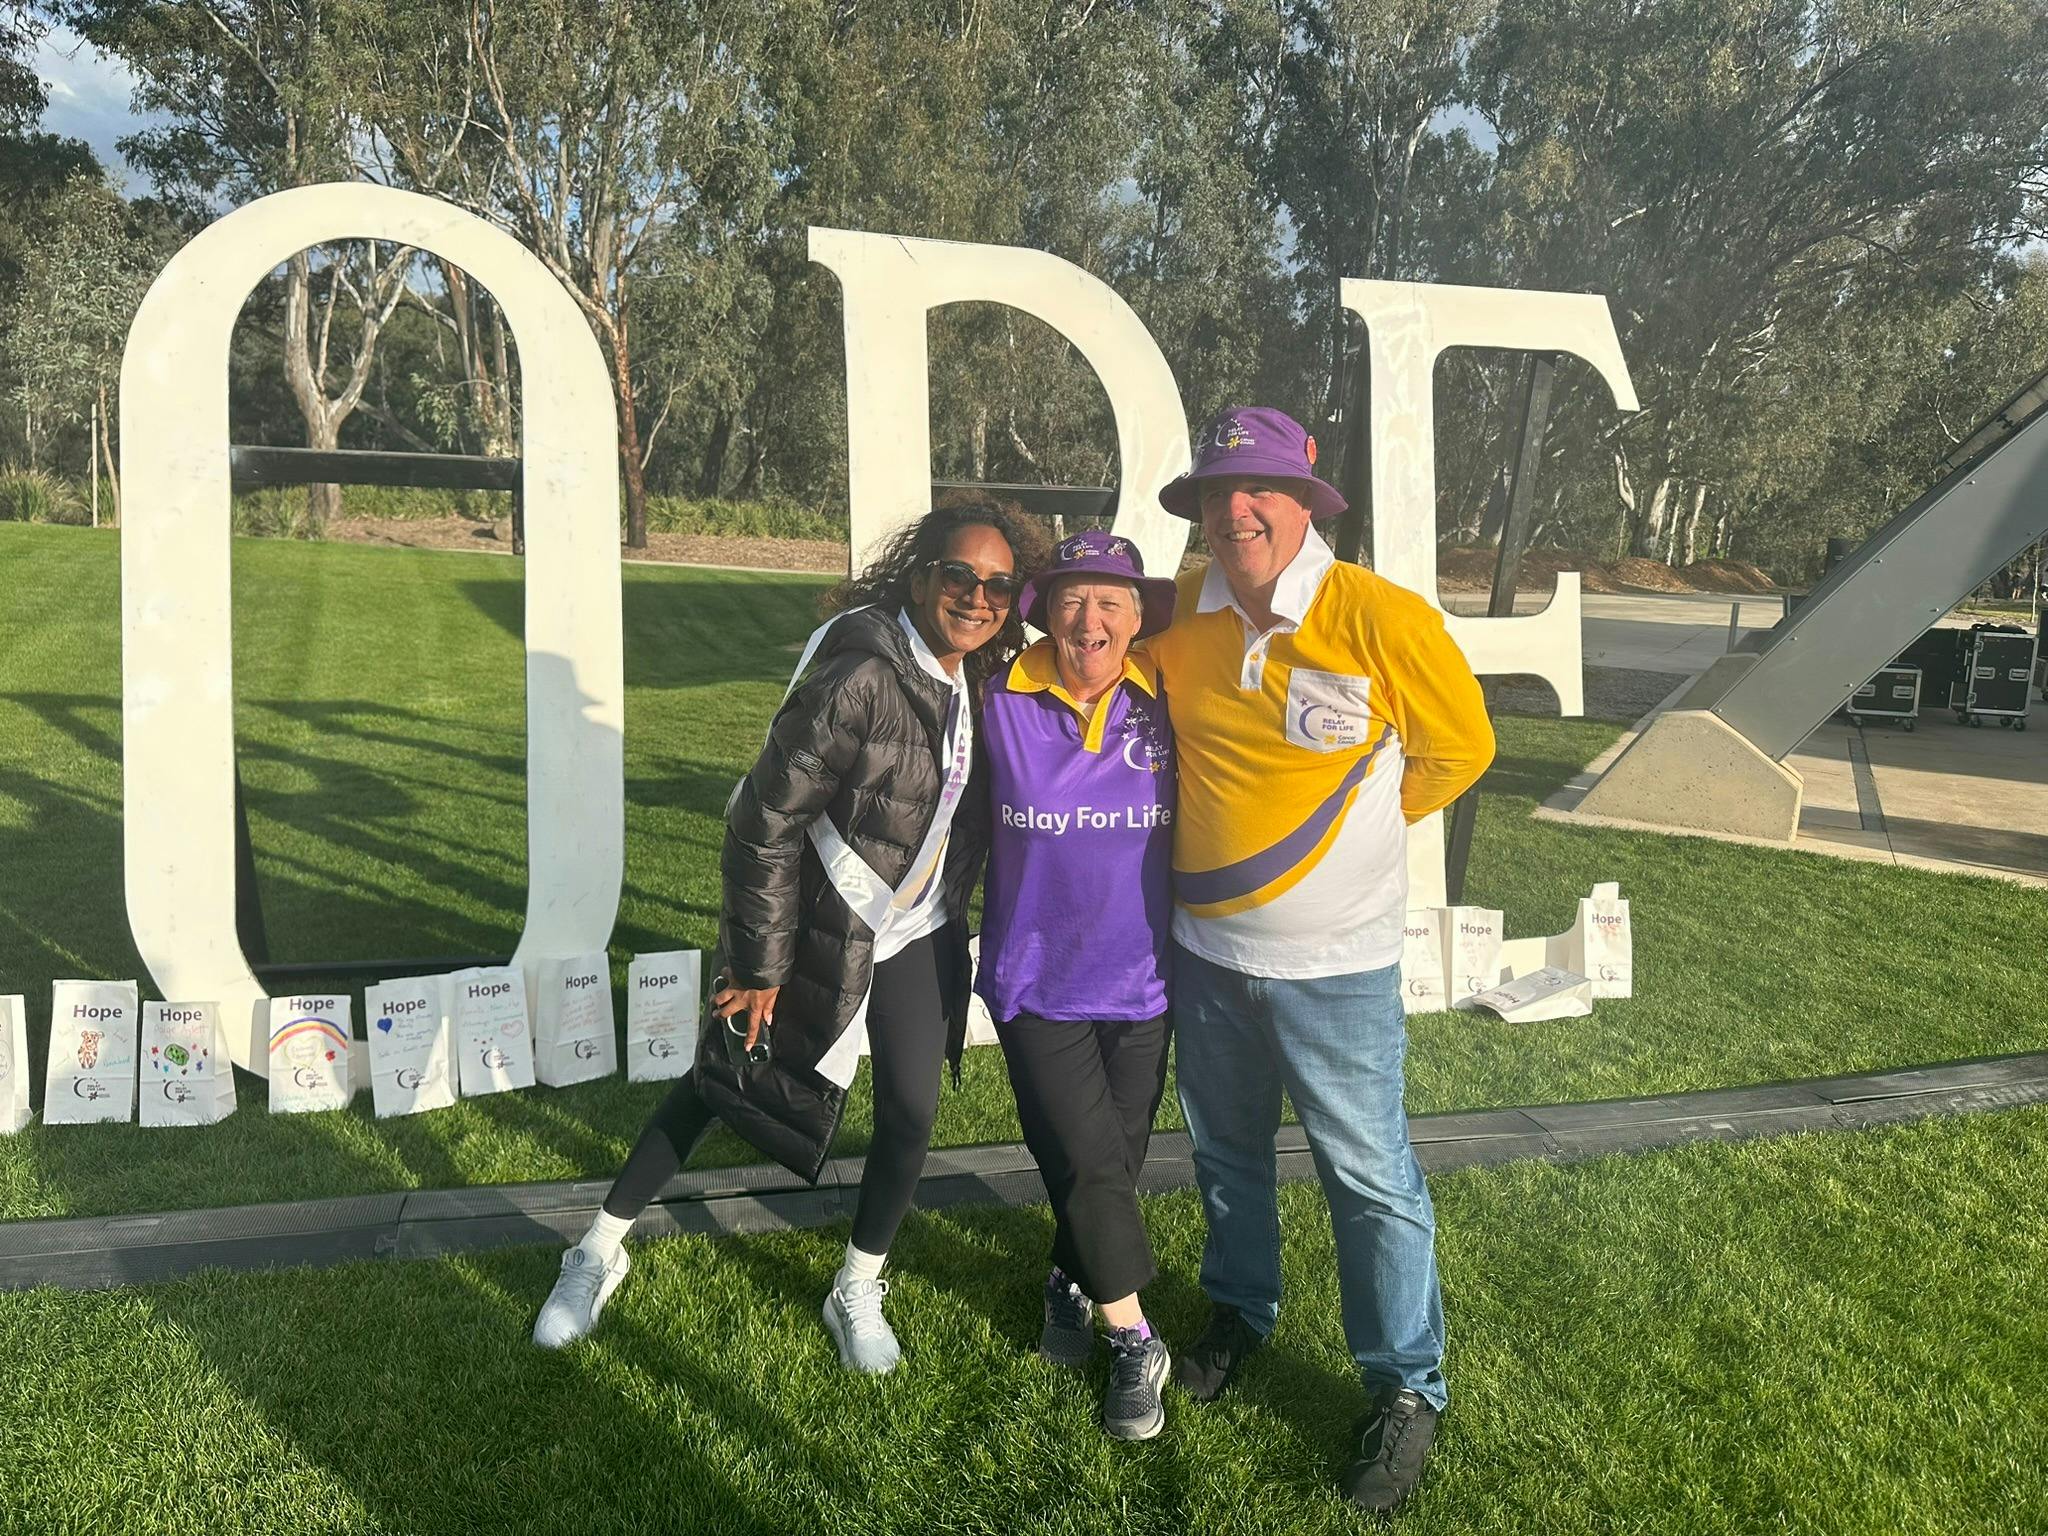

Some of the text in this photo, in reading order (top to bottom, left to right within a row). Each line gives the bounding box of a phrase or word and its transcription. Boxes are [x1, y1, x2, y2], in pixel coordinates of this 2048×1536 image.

[1323, 718, 1346, 726] RELAY
[944, 704, 968, 806] Carer
[1001, 803, 1172, 835] Relay For Life
[1592, 913, 1622, 926] Hope
[1460, 922, 1493, 937] Hope
[565, 974, 598, 990] Hope
[639, 974, 679, 989] Hope
[468, 982, 511, 998] Hope
[73, 1004, 123, 1022] Hope
[289, 998, 335, 1014] Hope
[383, 998, 427, 1016] Hope
[160, 1008, 203, 1025] Hope
